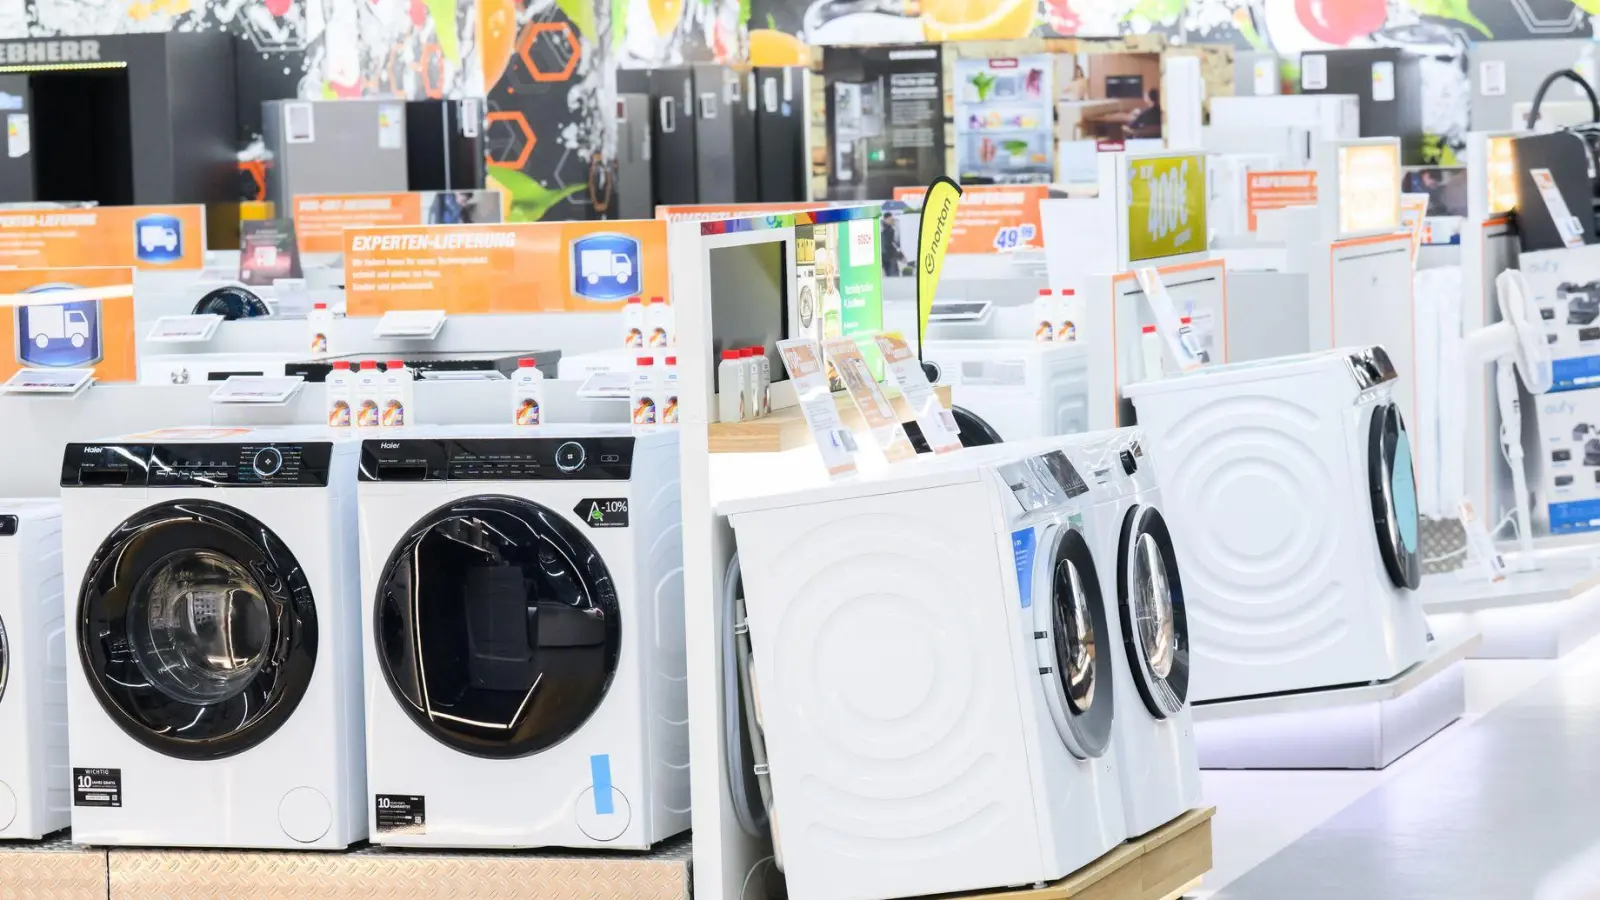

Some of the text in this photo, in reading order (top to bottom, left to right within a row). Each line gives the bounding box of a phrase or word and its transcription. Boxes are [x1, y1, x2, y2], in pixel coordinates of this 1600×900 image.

[931, 197, 952, 255] norton
[351, 232, 517, 251] EXPERTEN-LIEFERUNG
[601, 501, 628, 512] -10%
[78, 776, 92, 788] 10
[377, 797, 390, 809] 10
